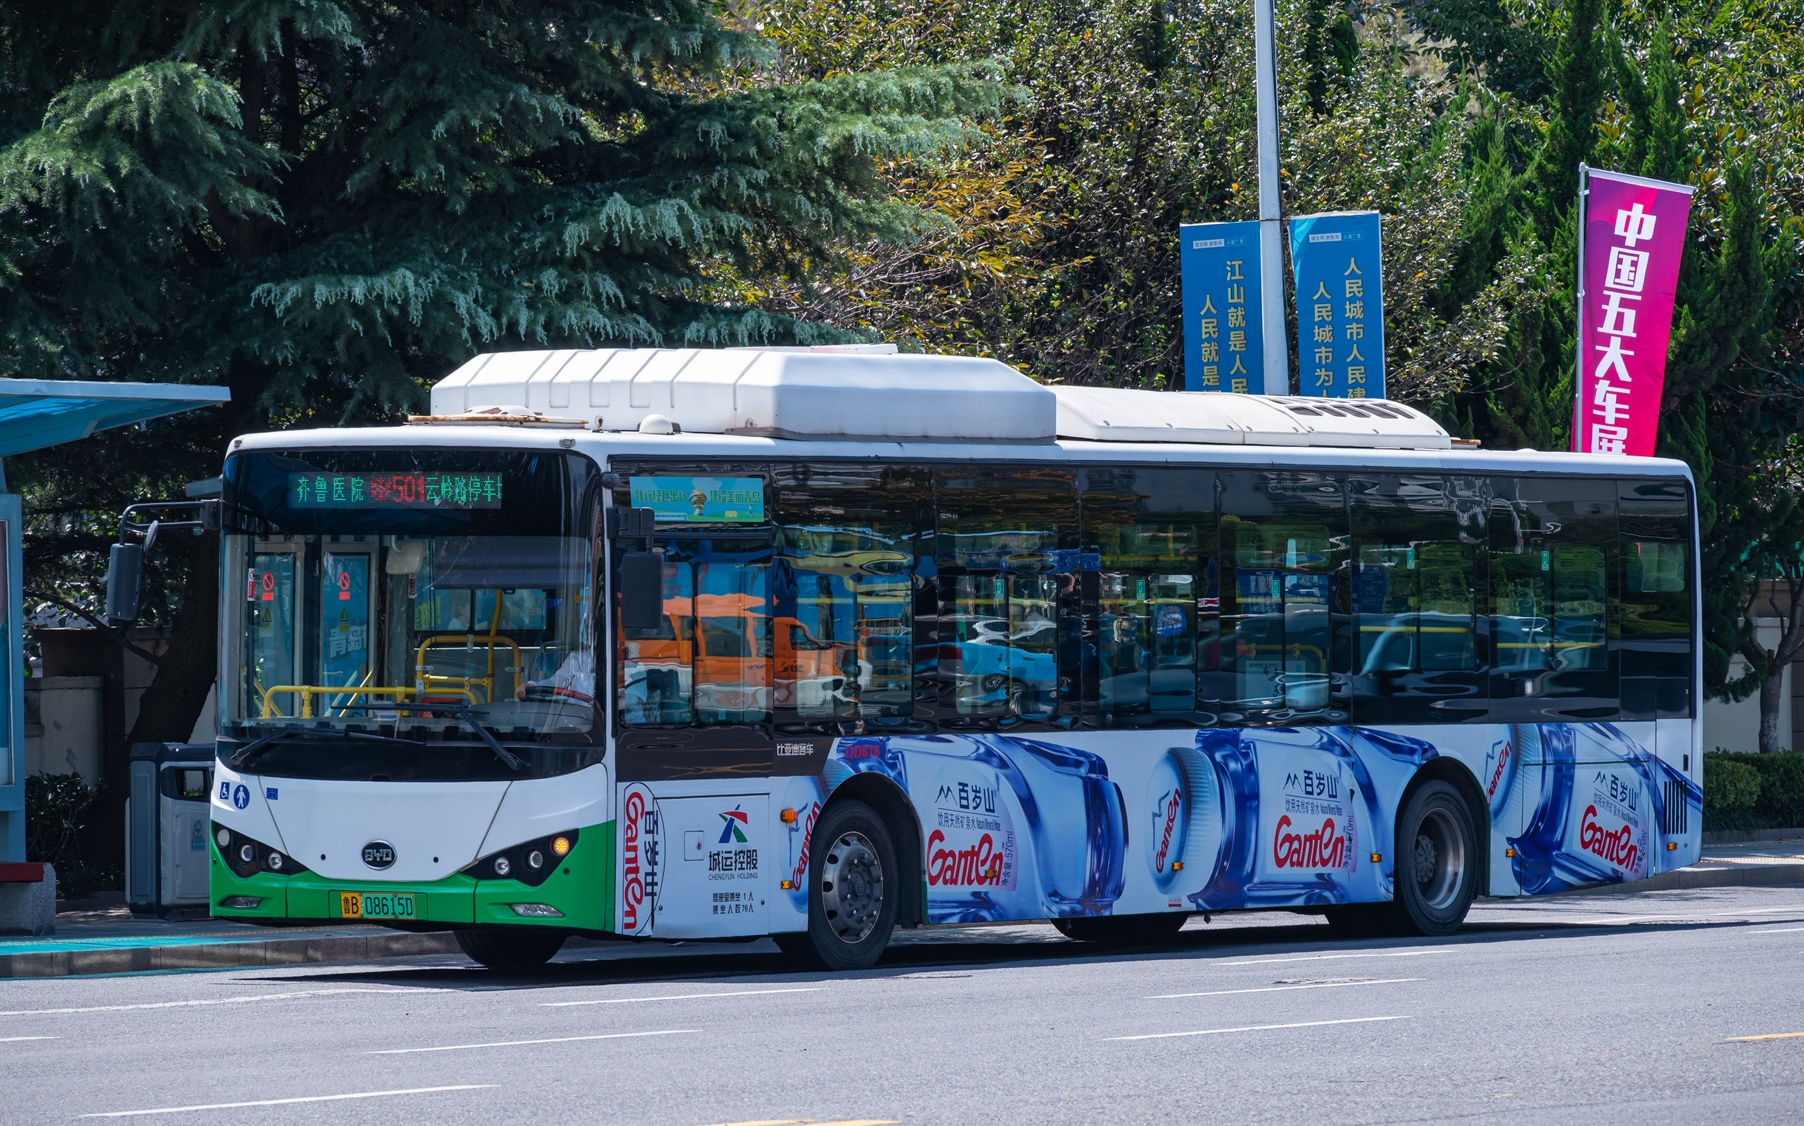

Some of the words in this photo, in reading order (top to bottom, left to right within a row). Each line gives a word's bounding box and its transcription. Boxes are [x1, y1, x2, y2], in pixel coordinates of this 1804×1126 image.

[1200, 294, 1221, 392] 人民就是
[1226, 260, 1248, 394] 江山就是人民
[1590, 202, 1657, 457] 中国五大车展
[296, 475, 364, 503] 齐鲁医院
[391, 475, 425, 503] 501
[710, 490, 760, 503] 建设美丽青岛
[330, 624, 367, 659] 青岛
[845, 745, 881, 759] DD676
[957, 781, 995, 814] 百岁山
[1303, 769, 1338, 799] 百岁山
[1609, 774, 1638, 812] 百岁山
[1155, 787, 1182, 874] Ganten
[1273, 814, 1345, 869] Ganten
[1580, 804, 1638, 872] Ganten
[364, 848, 393, 862] BYD
[623, 791, 645, 930] Ganten
[644, 810, 659, 897] 百岁山
[708, 849, 758, 872] 城运控股
[926, 829, 1004, 886] Ganten
[708, 873, 735, 881] CHENGYUN
[736, 872, 758, 880] HOLDING
[365, 896, 414, 916] 08615D
